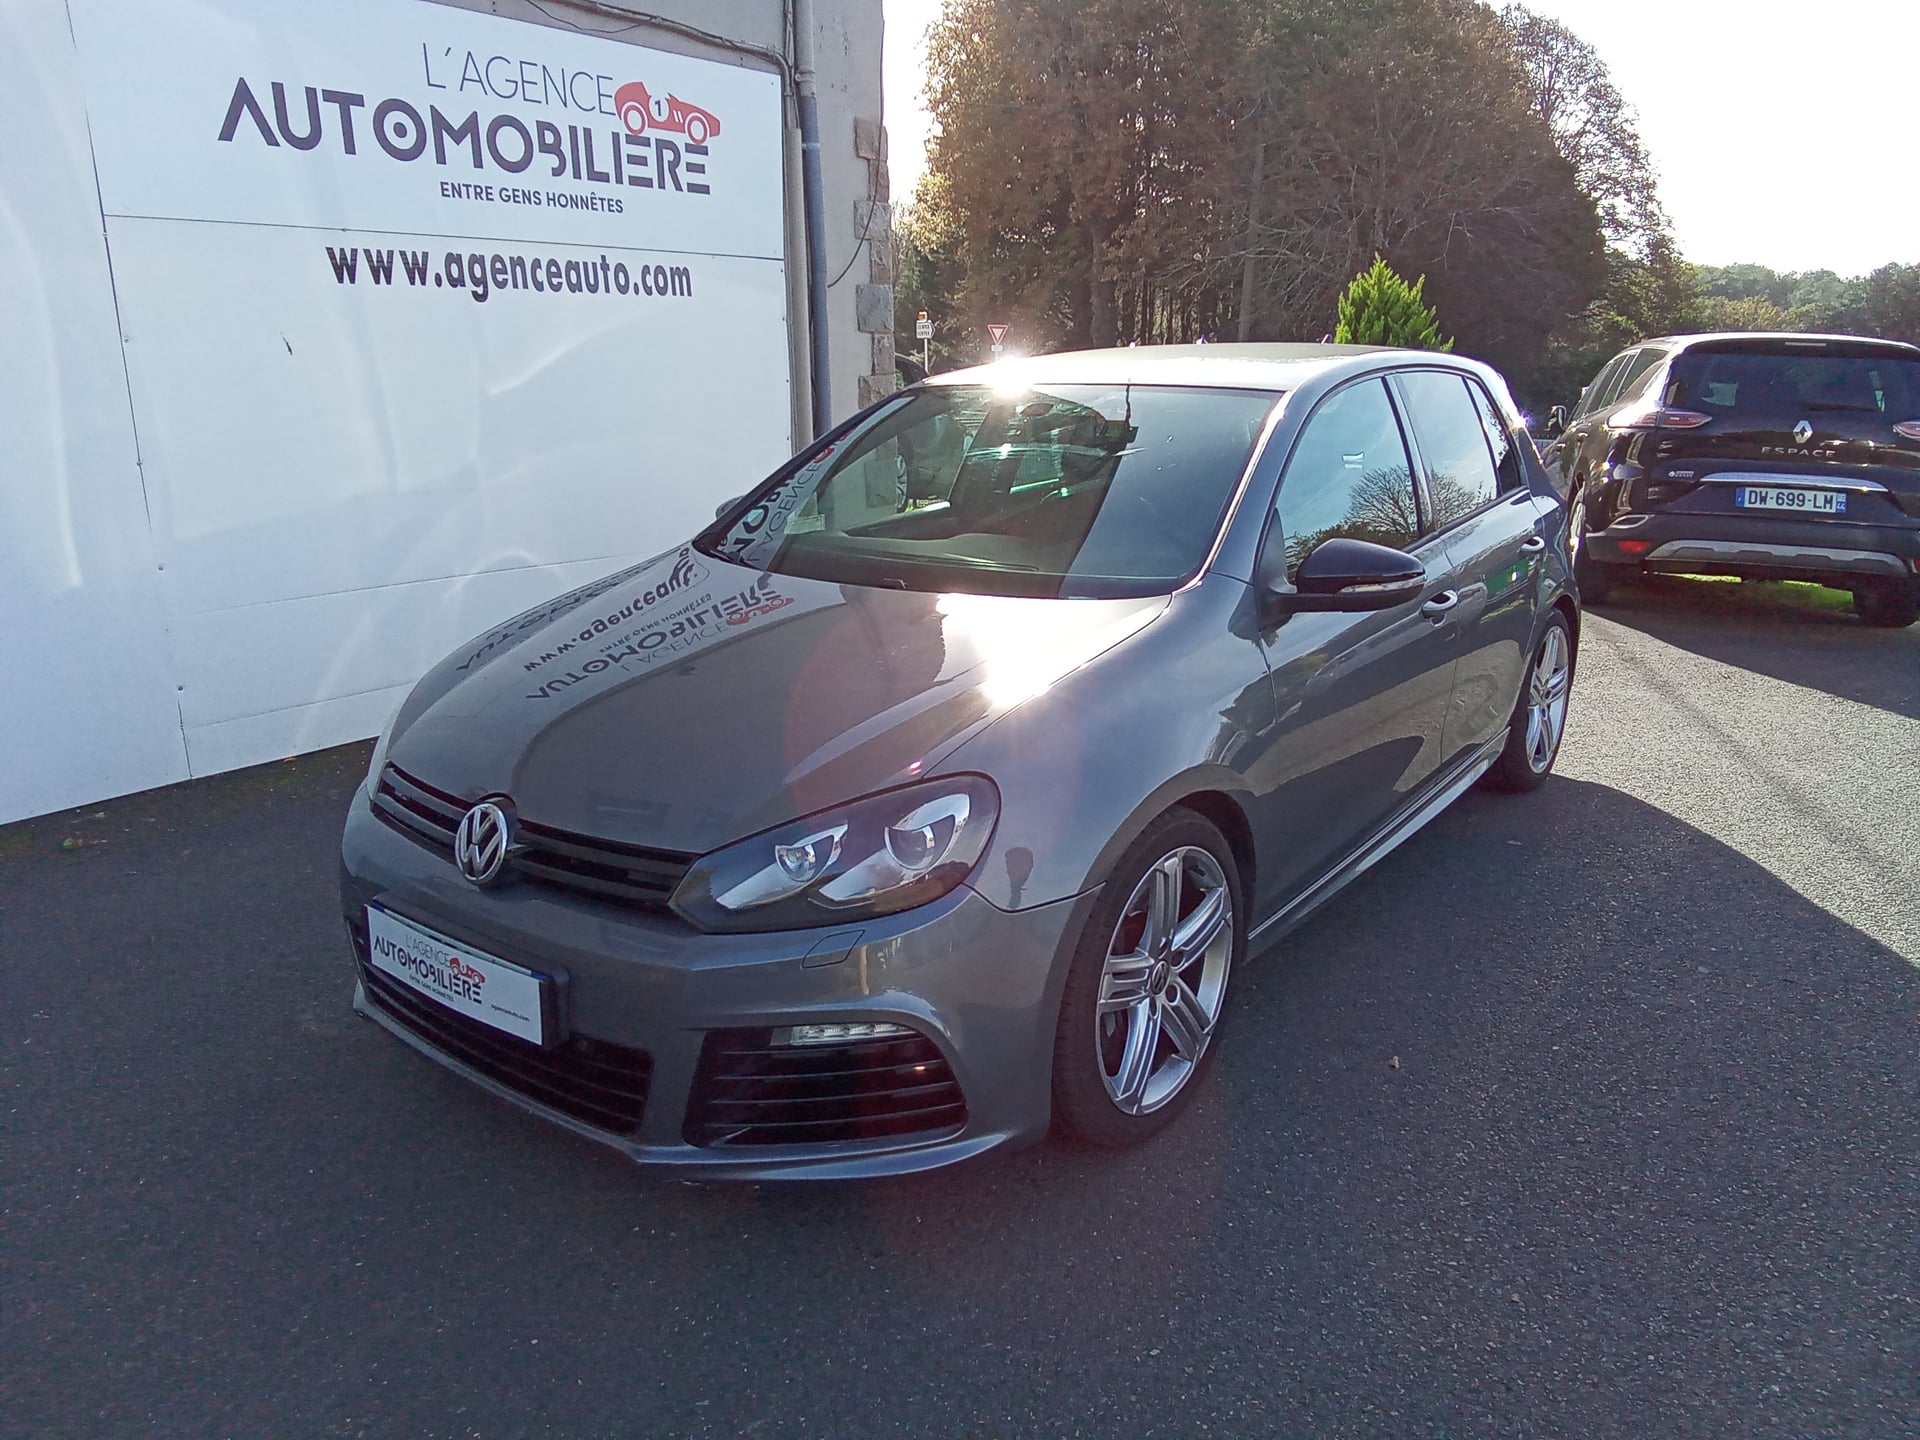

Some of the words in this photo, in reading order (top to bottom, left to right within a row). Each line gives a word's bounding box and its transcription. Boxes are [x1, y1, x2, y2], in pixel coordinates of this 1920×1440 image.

[422, 42, 617, 116] L'AGENCE
[440, 181, 494, 202] ENTRE
[498, 186, 542, 206] GENS
[546, 190, 624, 214] HONNÊTES
[325, 247, 692, 302] www.agenceauto.com
[1761, 446, 1837, 457] ESPACE
[1748, 490, 1834, 510] DW-699-LM
